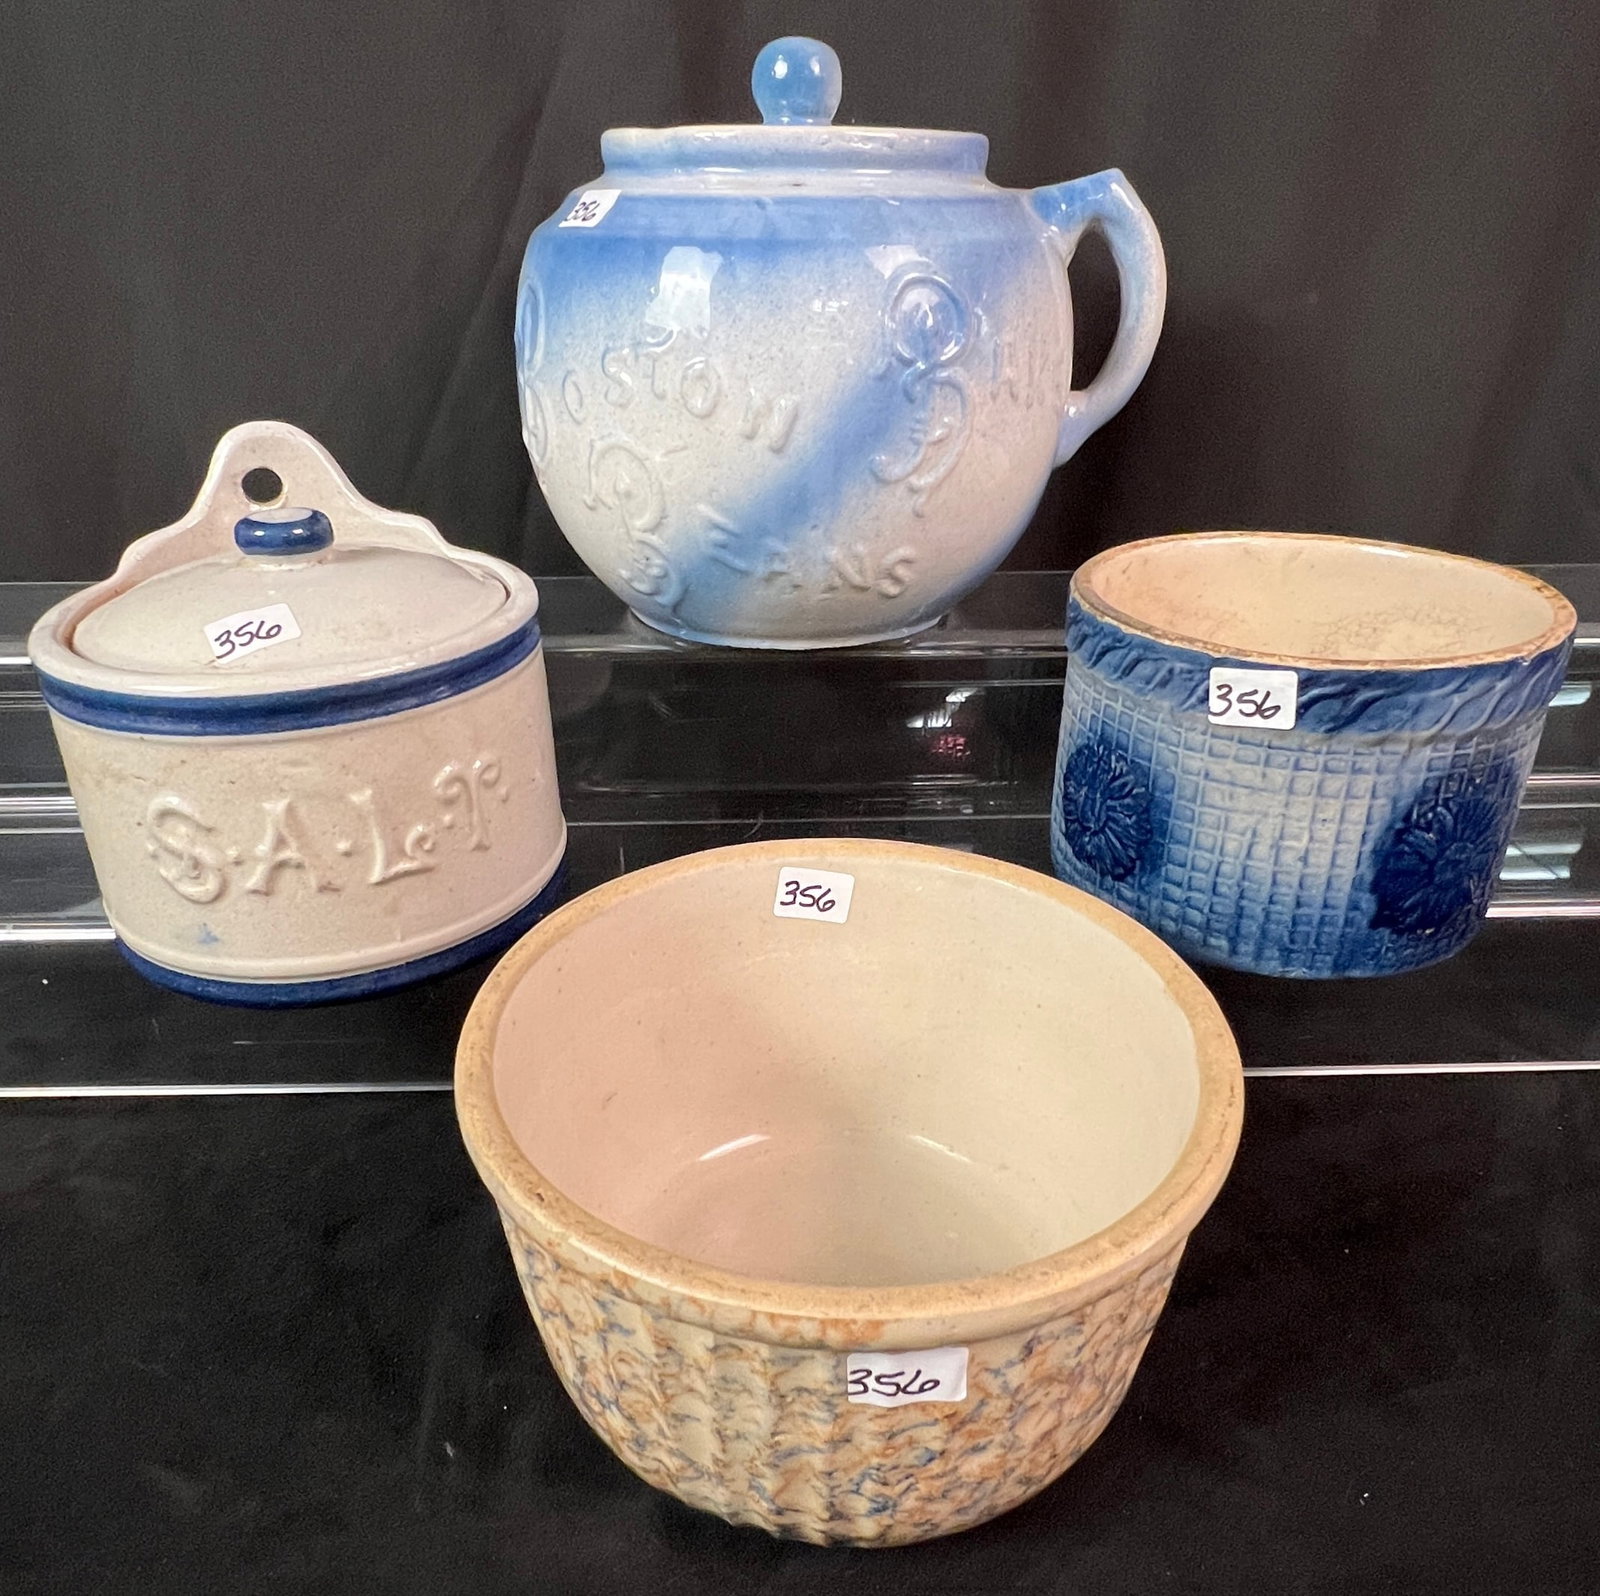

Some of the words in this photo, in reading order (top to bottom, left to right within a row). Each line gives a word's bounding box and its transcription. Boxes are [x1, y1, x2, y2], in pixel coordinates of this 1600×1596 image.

[564, 200, 600, 222] 356
[214, 620, 282, 660] 356
[1208, 683, 1281, 720] 356
[779, 880, 836, 913] 356
[847, 1368, 941, 1397] 356
